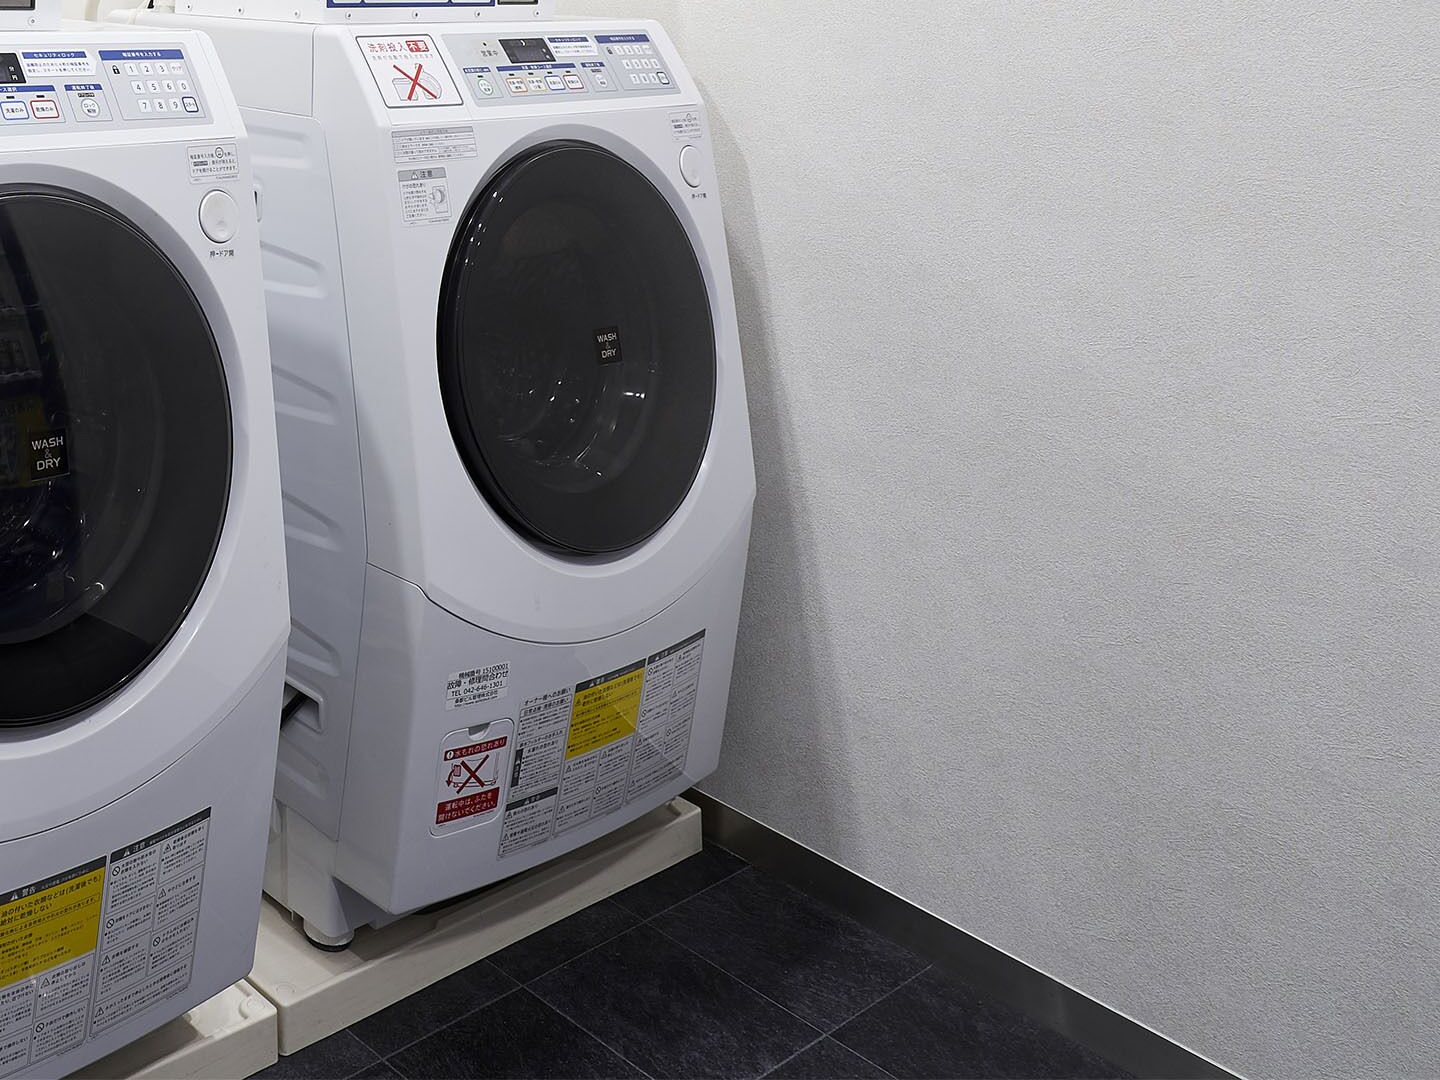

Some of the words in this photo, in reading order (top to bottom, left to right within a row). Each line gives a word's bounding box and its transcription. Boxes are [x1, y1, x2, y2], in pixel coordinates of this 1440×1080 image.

[368, 42, 407, 52] 洗剤投入
[420, 170, 432, 178] 注意
[597, 332, 616, 343] WASH
[601, 348, 616, 358] DRY
[32, 436, 63, 450] WASH
[45, 449, 52, 458] &
[37, 457, 60, 470] DRY
